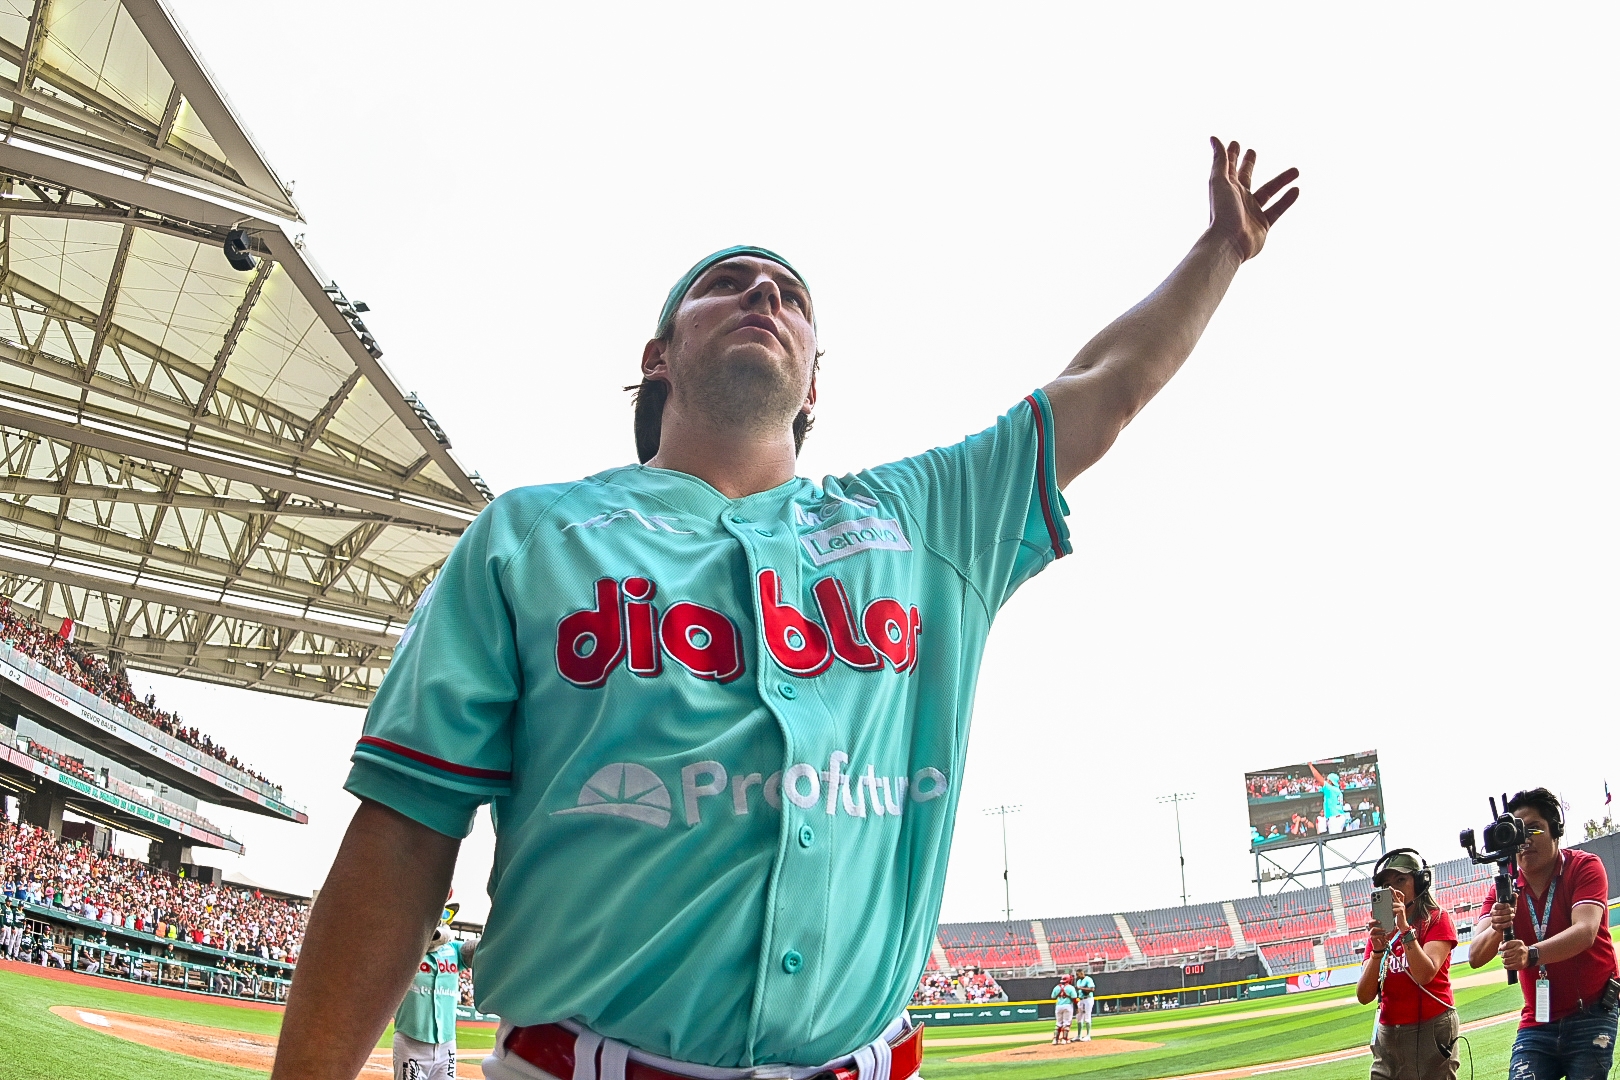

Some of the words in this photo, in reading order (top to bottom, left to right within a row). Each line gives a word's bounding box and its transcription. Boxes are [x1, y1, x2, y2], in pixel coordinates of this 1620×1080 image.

[810, 526, 899, 556] Lenovo
[81, 708, 101, 724] TREVOR
[100, 719, 117, 733] BAUER
